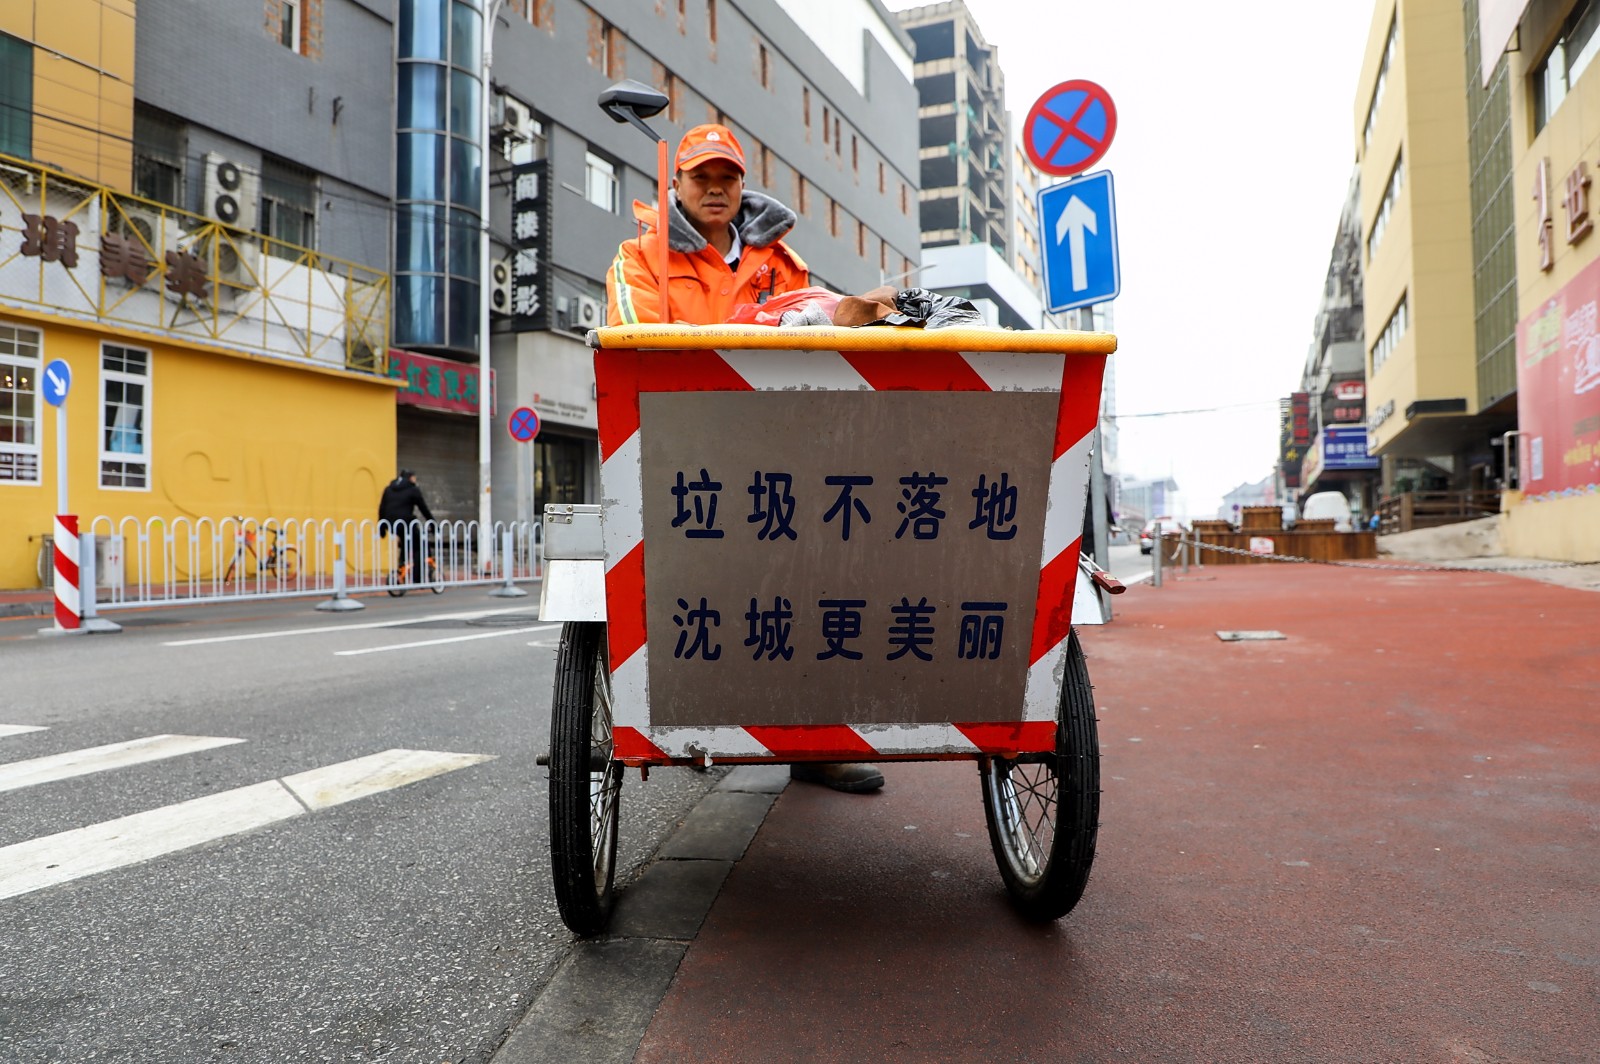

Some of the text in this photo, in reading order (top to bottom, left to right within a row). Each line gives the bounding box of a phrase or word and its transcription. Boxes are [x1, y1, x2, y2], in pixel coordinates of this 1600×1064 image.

[670, 468, 1019, 542] 垃圾不落地
[668, 596, 1009, 662] 沈城更美丽
